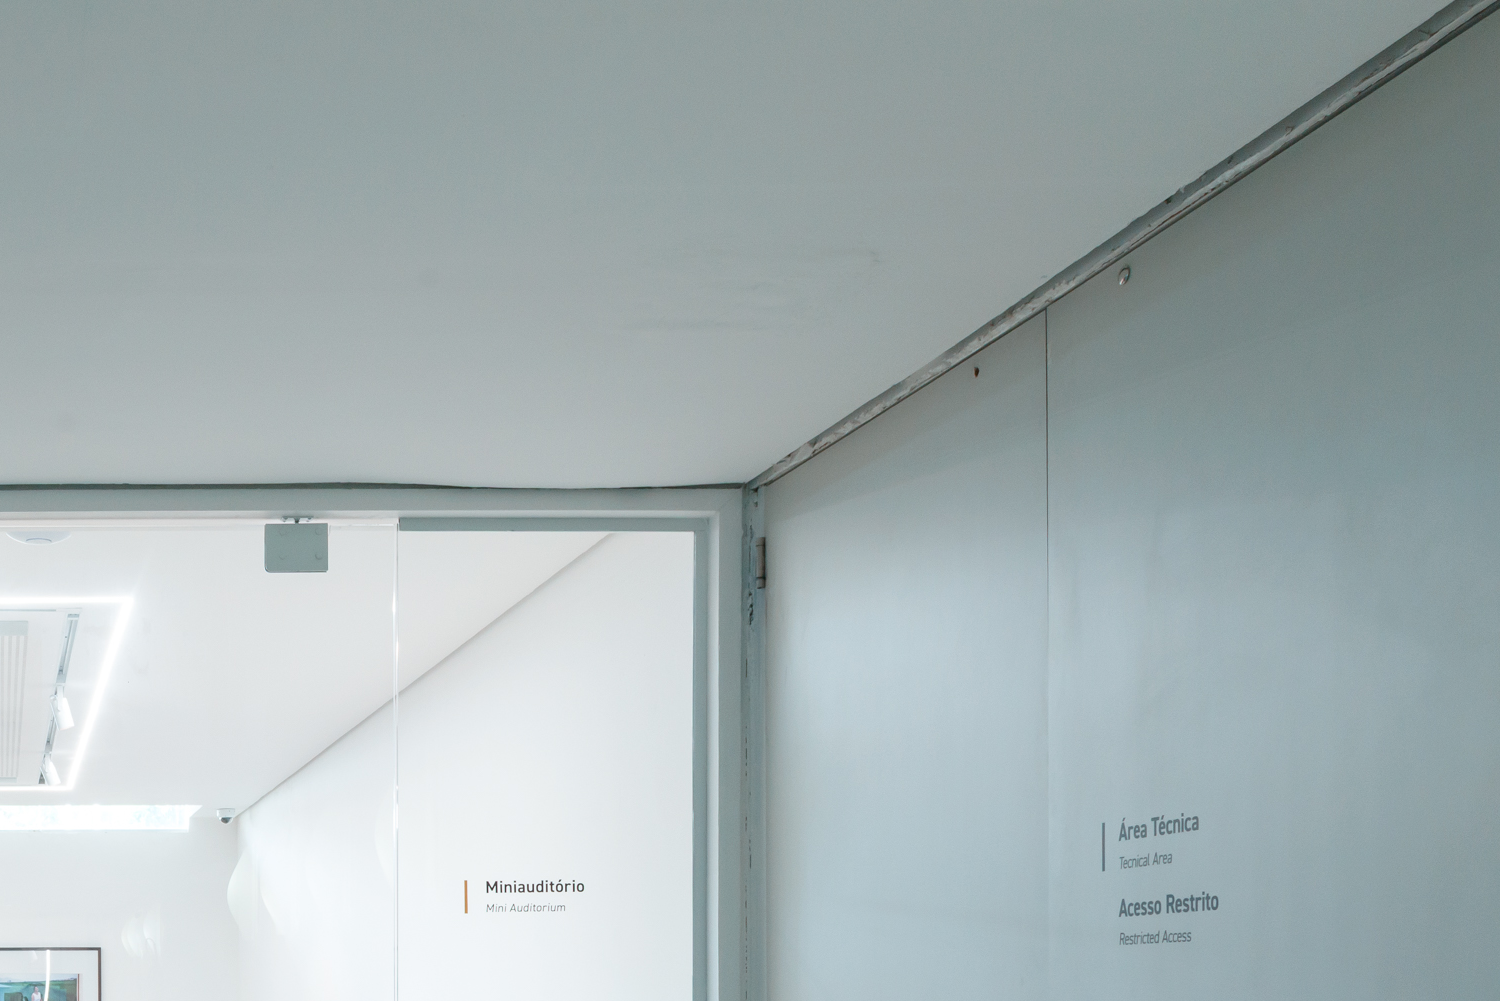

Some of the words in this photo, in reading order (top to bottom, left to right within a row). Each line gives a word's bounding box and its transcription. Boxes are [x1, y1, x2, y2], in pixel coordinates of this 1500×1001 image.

[1118, 817, 1148, 841] Área
[1151, 813, 1200, 837] Técnica
[1119, 853, 1150, 869] Tecnical
[1152, 852, 1173, 866] Area
[485, 879, 585, 894] Miniauditório
[485, 903, 507, 913] Mini
[509, 902, 566, 913] Auditorium
[1118, 898, 1162, 917] Acesso
[1165, 891, 1219, 914] Restrito
[1119, 930, 1160, 945] Restricted
[1161, 929, 1192, 943] Access
